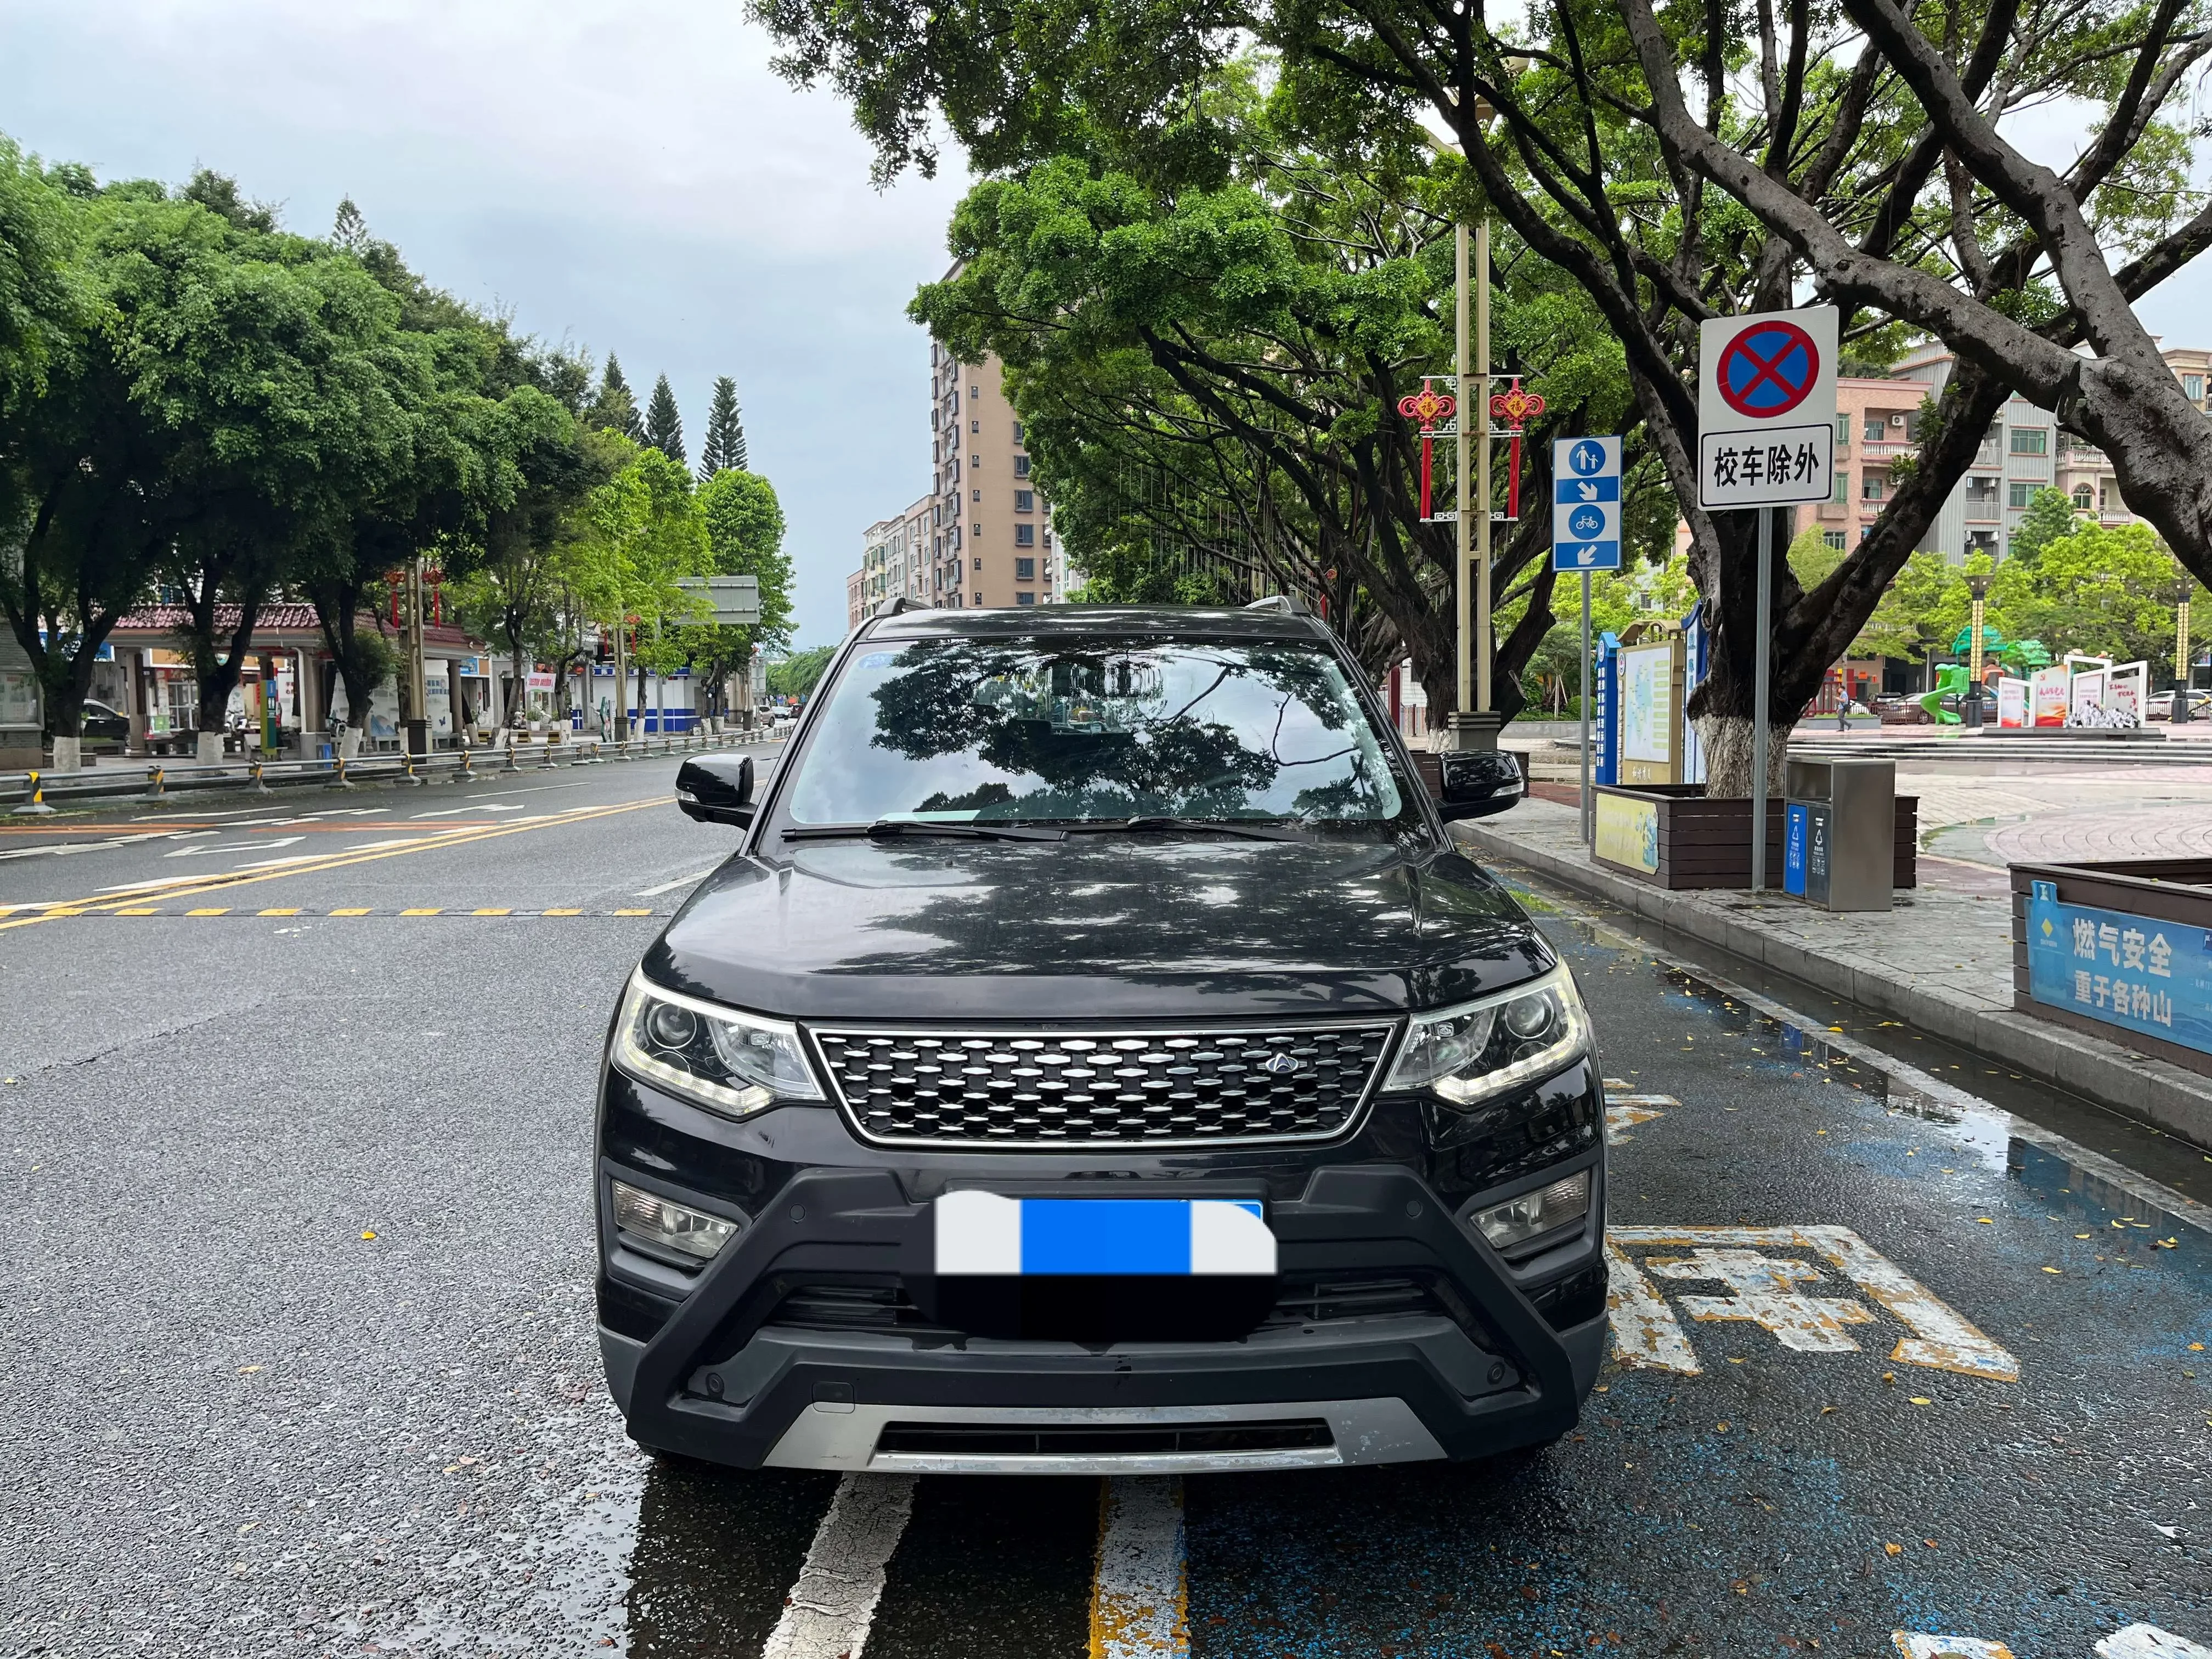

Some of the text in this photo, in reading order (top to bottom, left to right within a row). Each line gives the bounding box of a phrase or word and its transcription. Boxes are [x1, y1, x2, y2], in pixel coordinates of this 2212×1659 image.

[1421, 400, 1433, 413] 福
[1510, 400, 1522, 413] 福
[1713, 442, 1819, 487] 校车除外
[2073, 917, 2172, 978] 燃气安全
[2074, 969, 2171, 1028] 重于各种山
